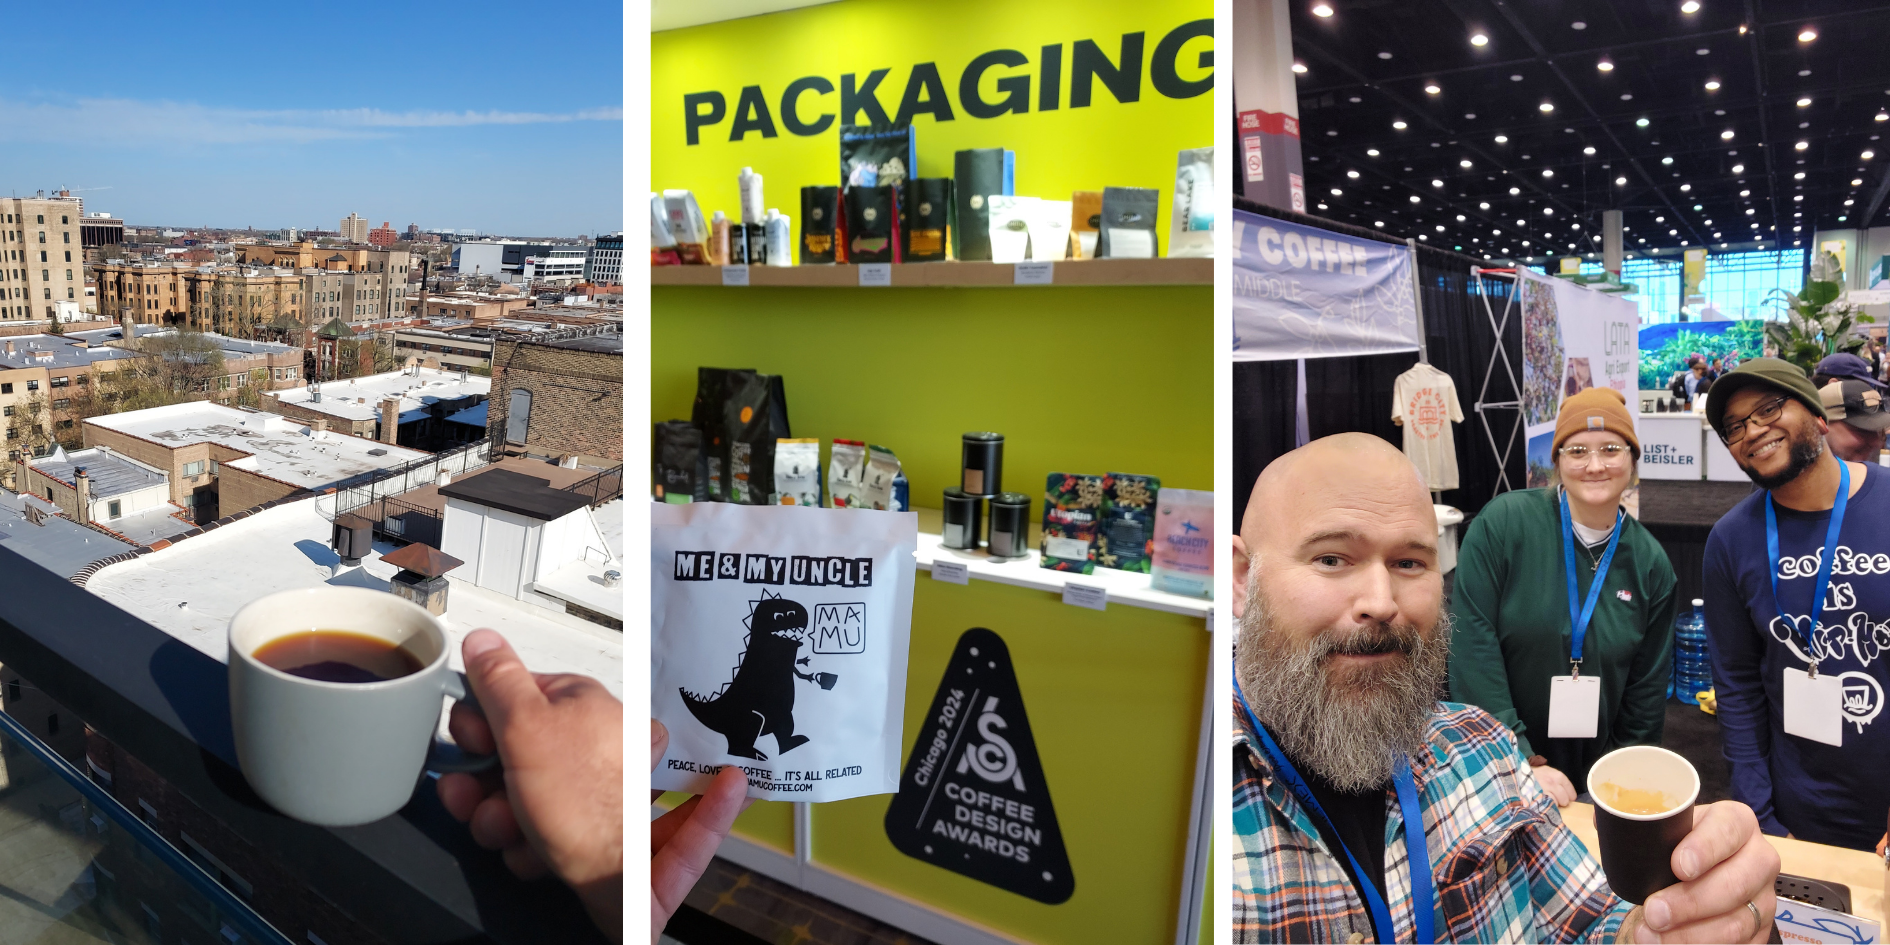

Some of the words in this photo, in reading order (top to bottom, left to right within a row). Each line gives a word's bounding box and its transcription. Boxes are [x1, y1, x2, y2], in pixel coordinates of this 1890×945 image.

[684, 18, 1214, 146] PACKAGING
[1185, 178, 1194, 204] LAKE
[1181, 206, 1190, 233] BEAR
[1257, 226, 1368, 277] COFFEE
[1233, 273, 1302, 301] MIDDLE
[1604, 320, 1631, 356] LATA
[1409, 388, 1432, 415] BRIDGE
[1643, 454, 1694, 465] BEISLER
[676, 553, 712, 580] ME
[720, 554, 737, 577] &
[747, 556, 784, 582] MY
[792, 558, 870, 586] UNCLE
[818, 606, 861, 625] MA
[819, 625, 861, 650] MU
[914, 728, 948, 788] Chicago
[938, 688, 966, 729] 2024
[668, 759, 697, 774] PEACE,
[785, 771, 801, 782] IT'S
[804, 771, 823, 781] ALL
[825, 765, 863, 780] RELATED
[944, 782, 1036, 824] COFFEE
[954, 804, 1043, 847] DESIGN
[932, 818, 1031, 864] AWARDS
[1779, 929, 1823, 944] spresso
